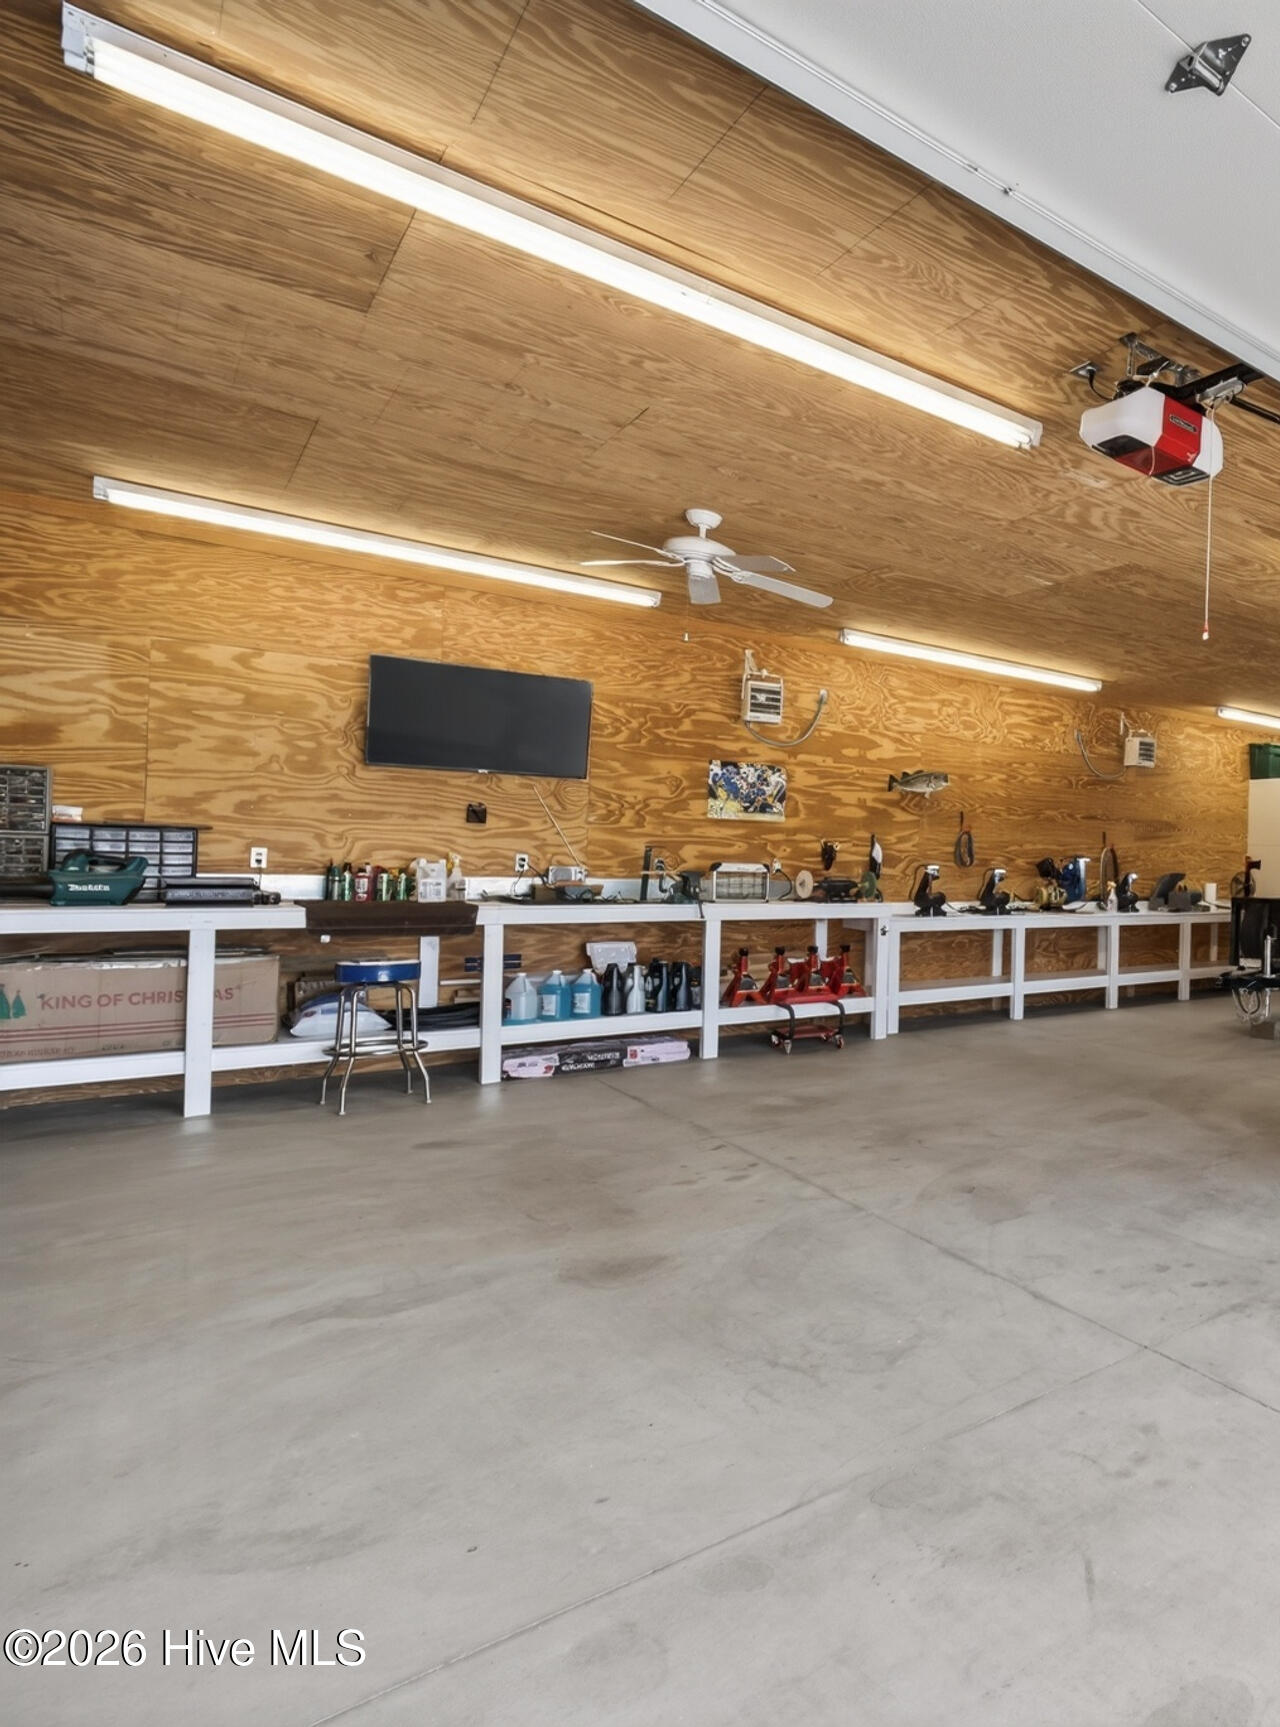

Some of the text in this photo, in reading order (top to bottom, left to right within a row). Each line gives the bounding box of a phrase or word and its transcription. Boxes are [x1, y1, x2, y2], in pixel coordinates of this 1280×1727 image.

[41, 987, 234, 1011] KING OF CHRISAS
